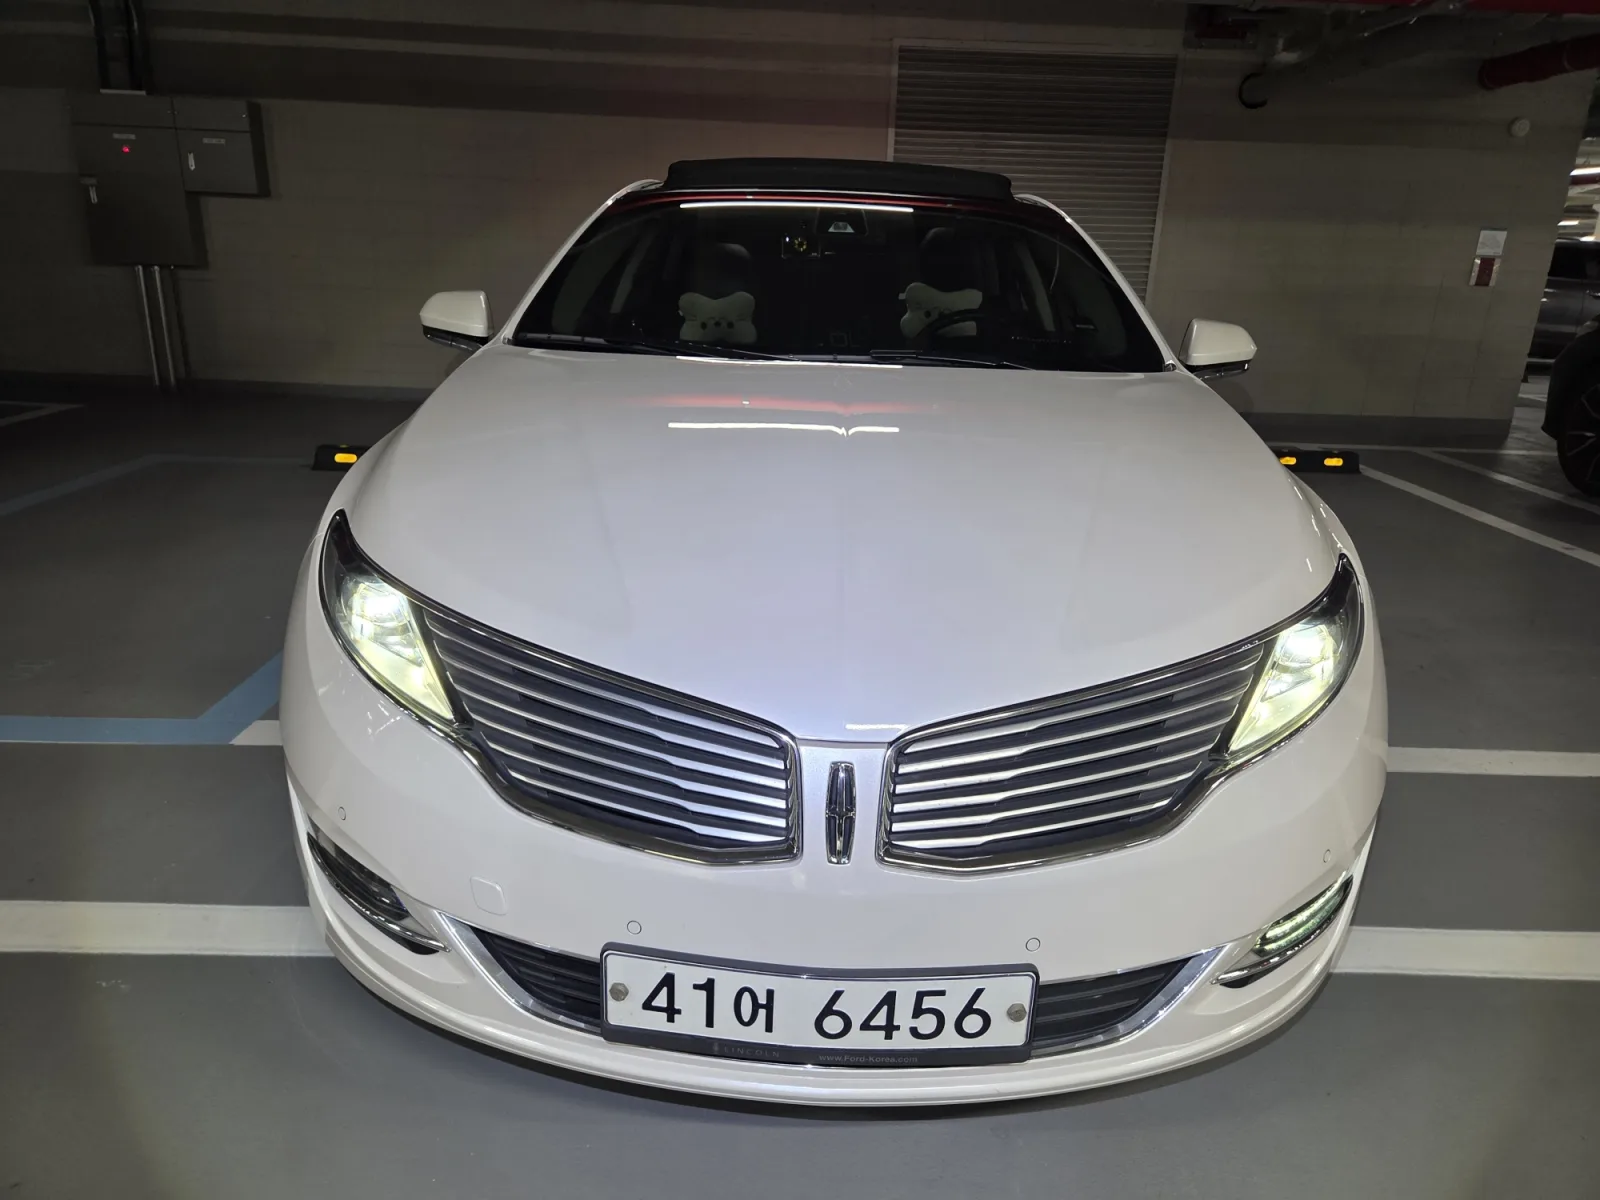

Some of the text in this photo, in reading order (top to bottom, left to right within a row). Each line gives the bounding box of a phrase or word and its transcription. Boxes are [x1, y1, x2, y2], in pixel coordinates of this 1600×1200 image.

[641, 972, 992, 1041] 41어 6456
[724, 1045, 780, 1057] LINCOLN
[819, 1053, 918, 1064] www.Ford-Korea.com
